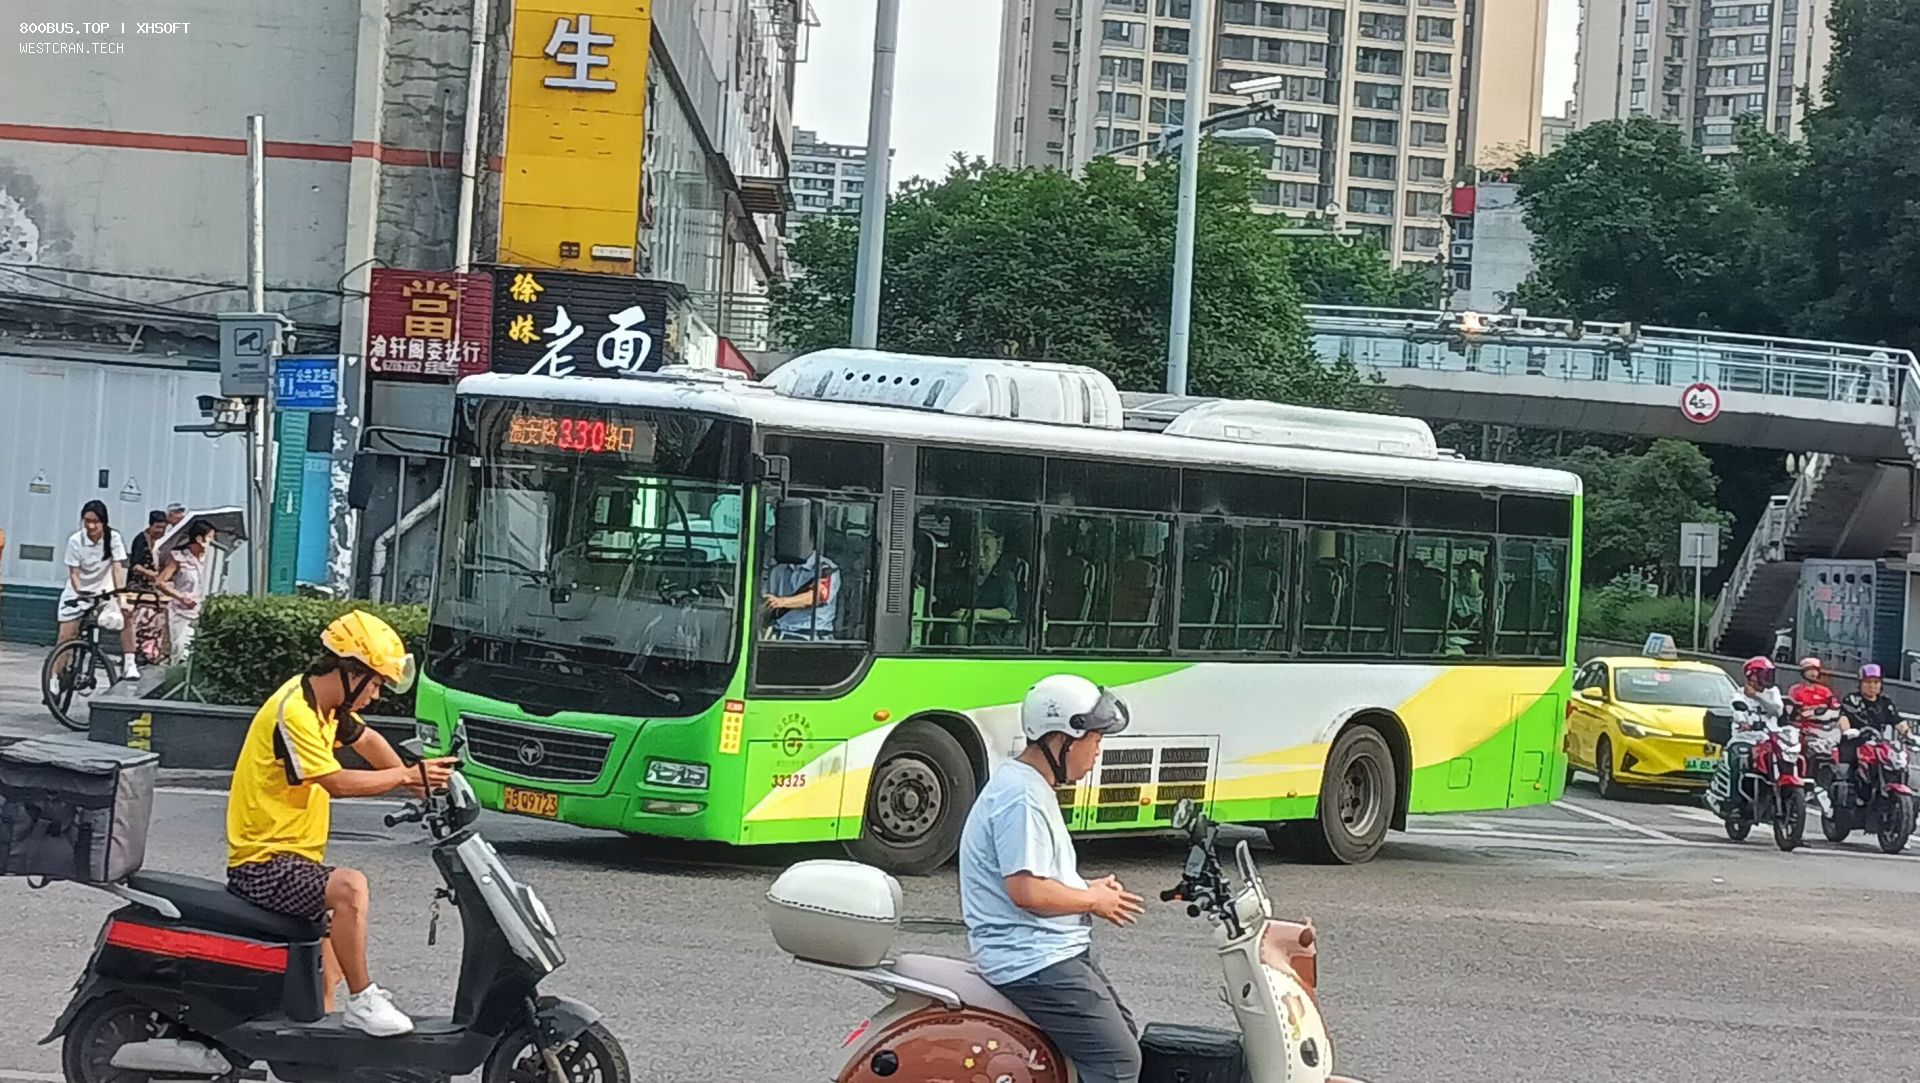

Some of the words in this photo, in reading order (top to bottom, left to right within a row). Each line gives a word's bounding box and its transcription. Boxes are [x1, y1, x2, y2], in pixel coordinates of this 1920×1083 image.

[544, 14, 616, 90] 生
[402, 280, 458, 339] 當
[525, 305, 652, 377] 老面
[559, 418, 605, 452] 330
[771, 774, 806, 788] 33325
